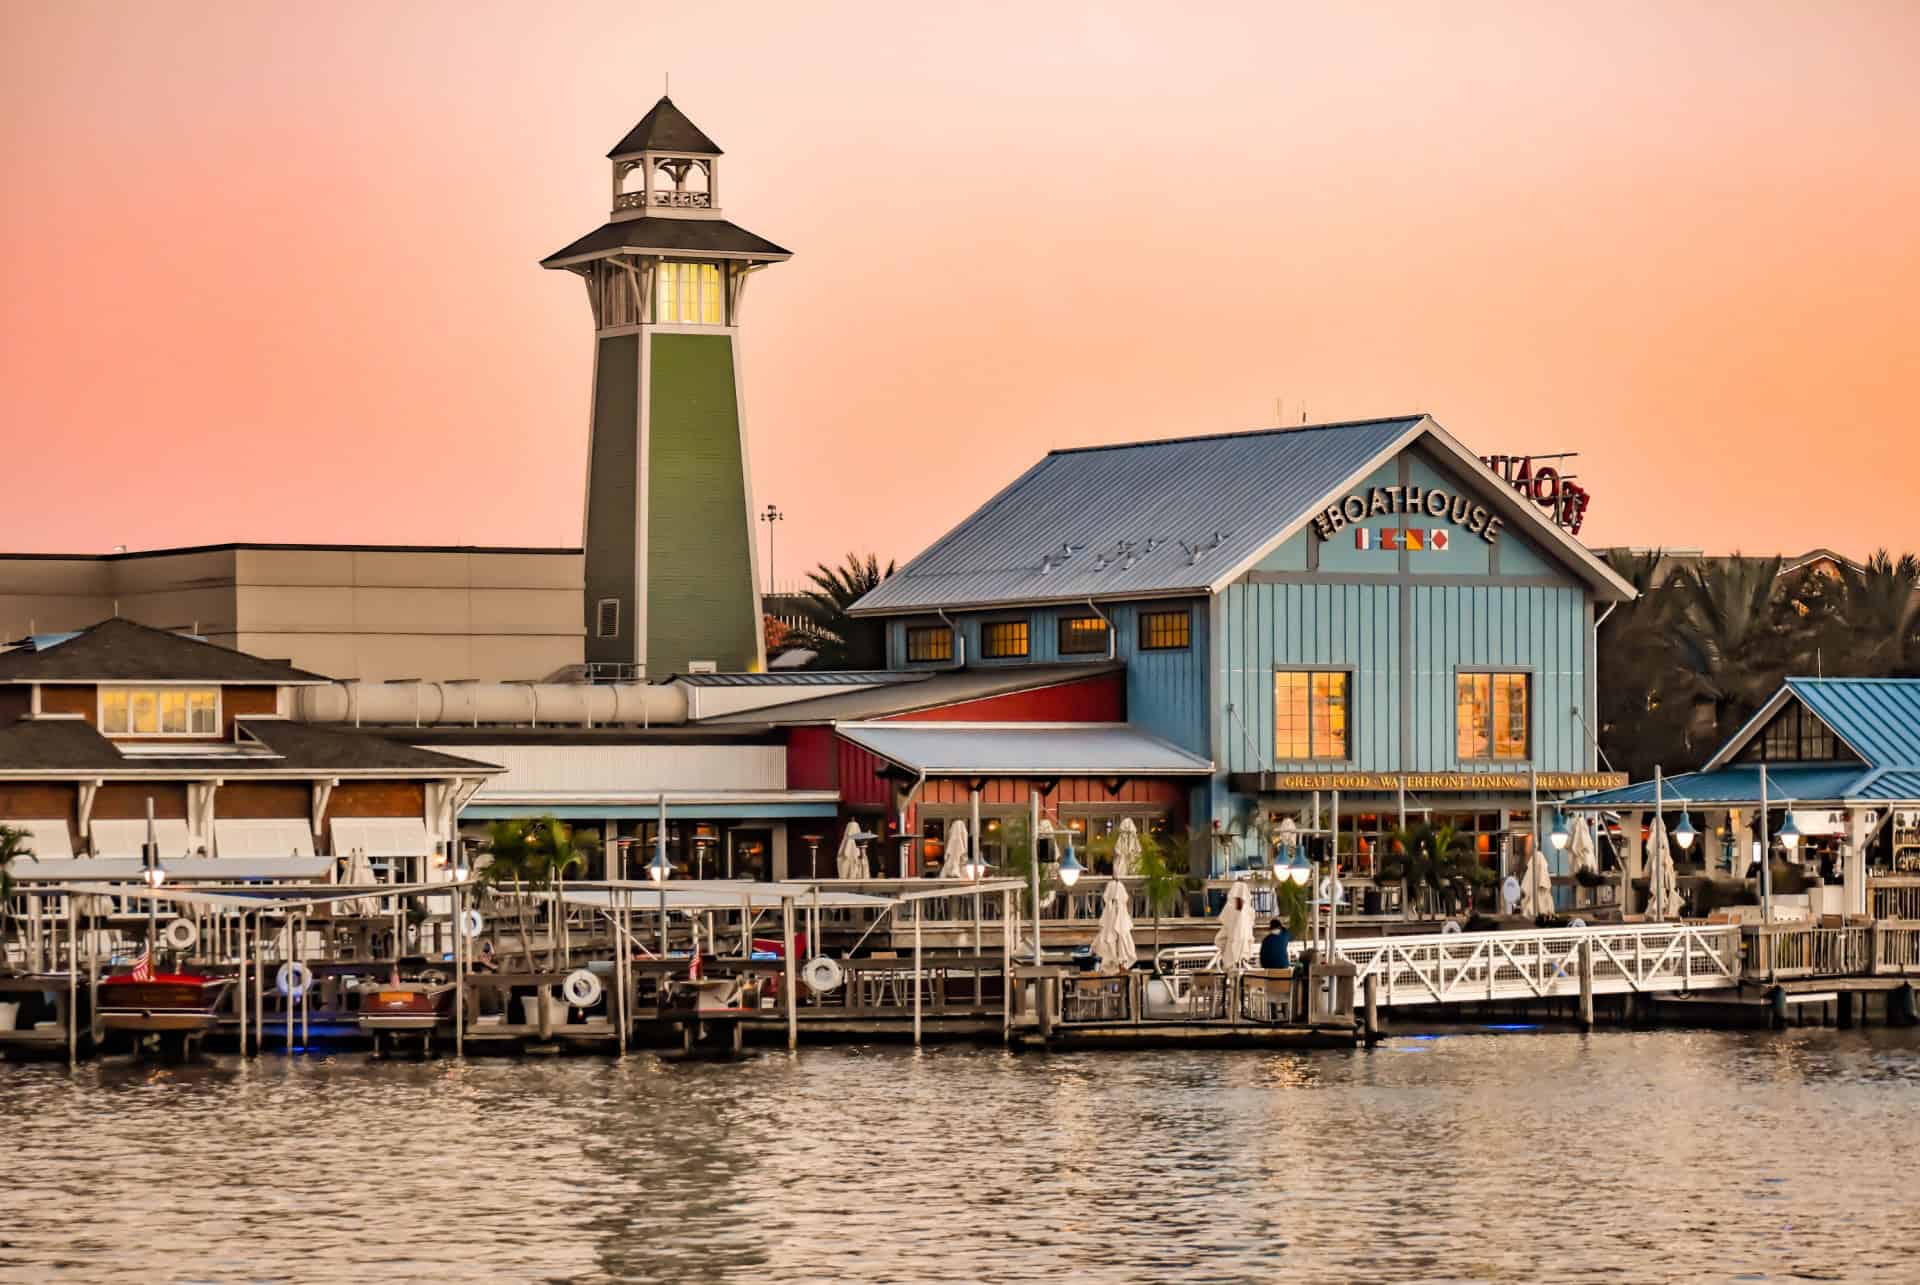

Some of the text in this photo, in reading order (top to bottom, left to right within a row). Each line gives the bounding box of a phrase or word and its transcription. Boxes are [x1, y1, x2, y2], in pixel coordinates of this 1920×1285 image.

[1326, 486, 1503, 543] BOATHOUSE
[1285, 775, 1328, 788] GREAT
[1333, 775, 1370, 788] FOOD
[1379, 775, 1466, 788] WAERFRONT
[1471, 775, 1520, 788] DINING
[1580, 775, 1621, 788] BOATS
